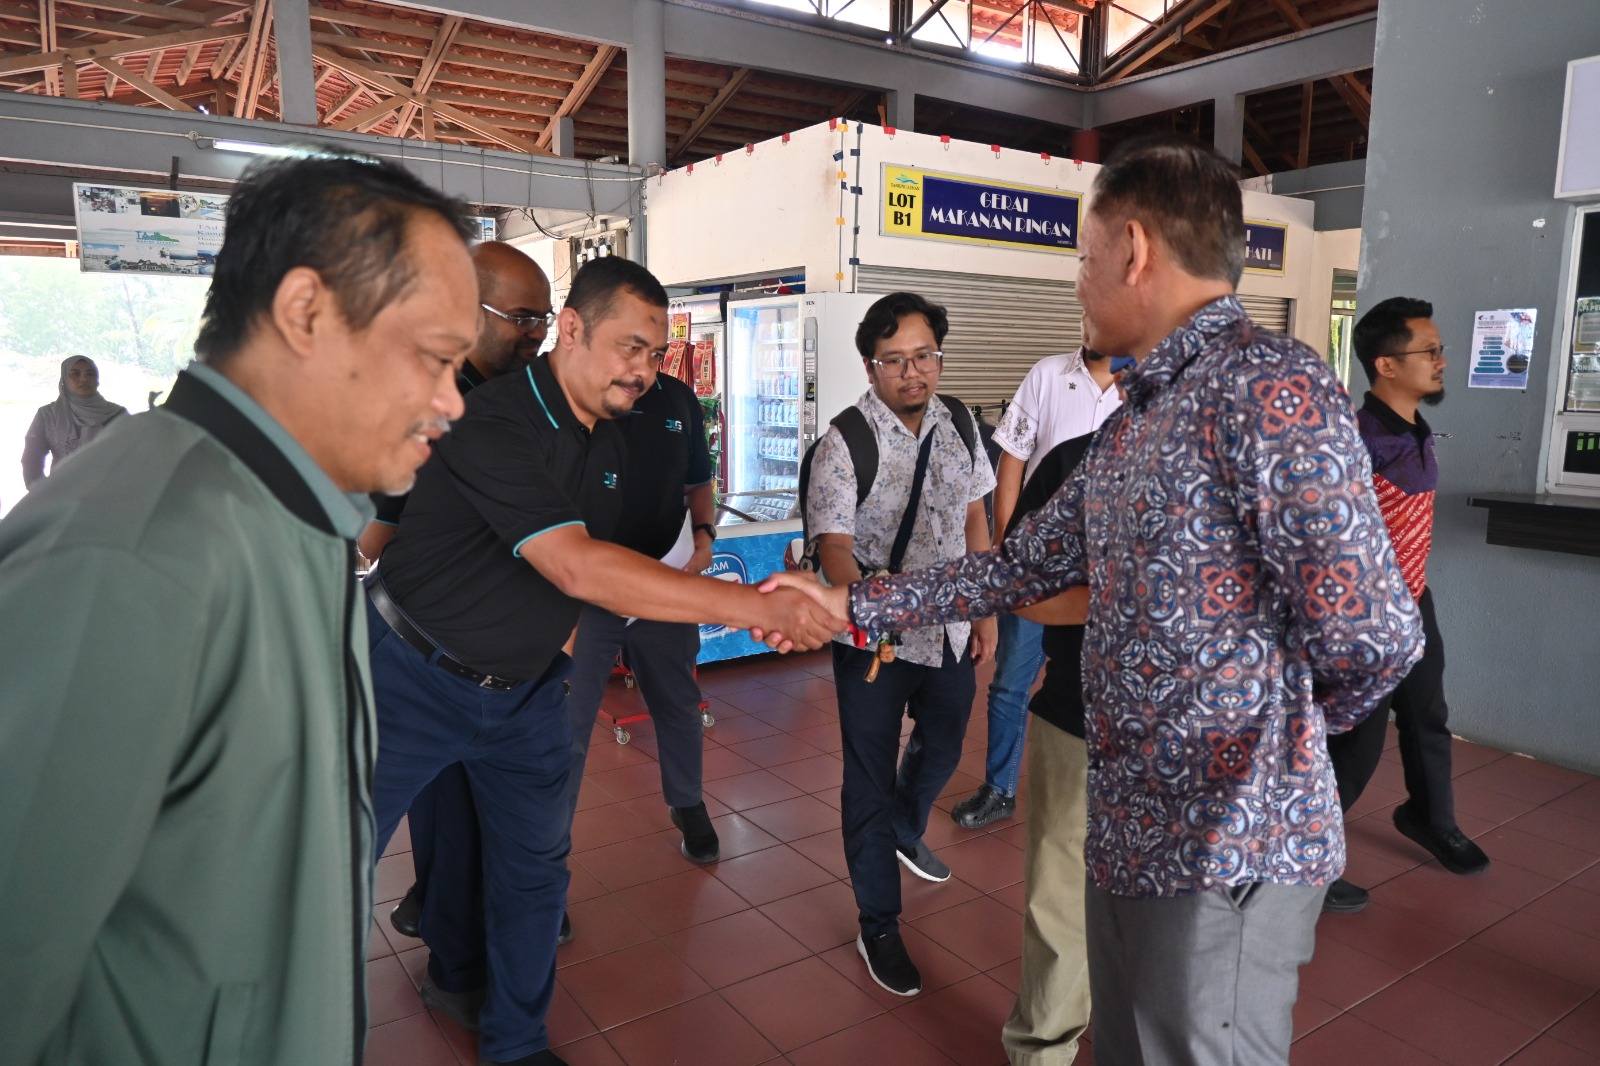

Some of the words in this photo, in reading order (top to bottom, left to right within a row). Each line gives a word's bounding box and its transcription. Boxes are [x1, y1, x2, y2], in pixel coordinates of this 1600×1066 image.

[888, 192, 916, 209] LOT
[979, 191, 1029, 213] GERAI
[893, 211, 912, 227] B1
[929, 206, 1012, 231] MAKANAN
[1015, 217, 1072, 238] RINGAN
[1244, 245, 1272, 261] HATI
[700, 560, 729, 576] REAM
